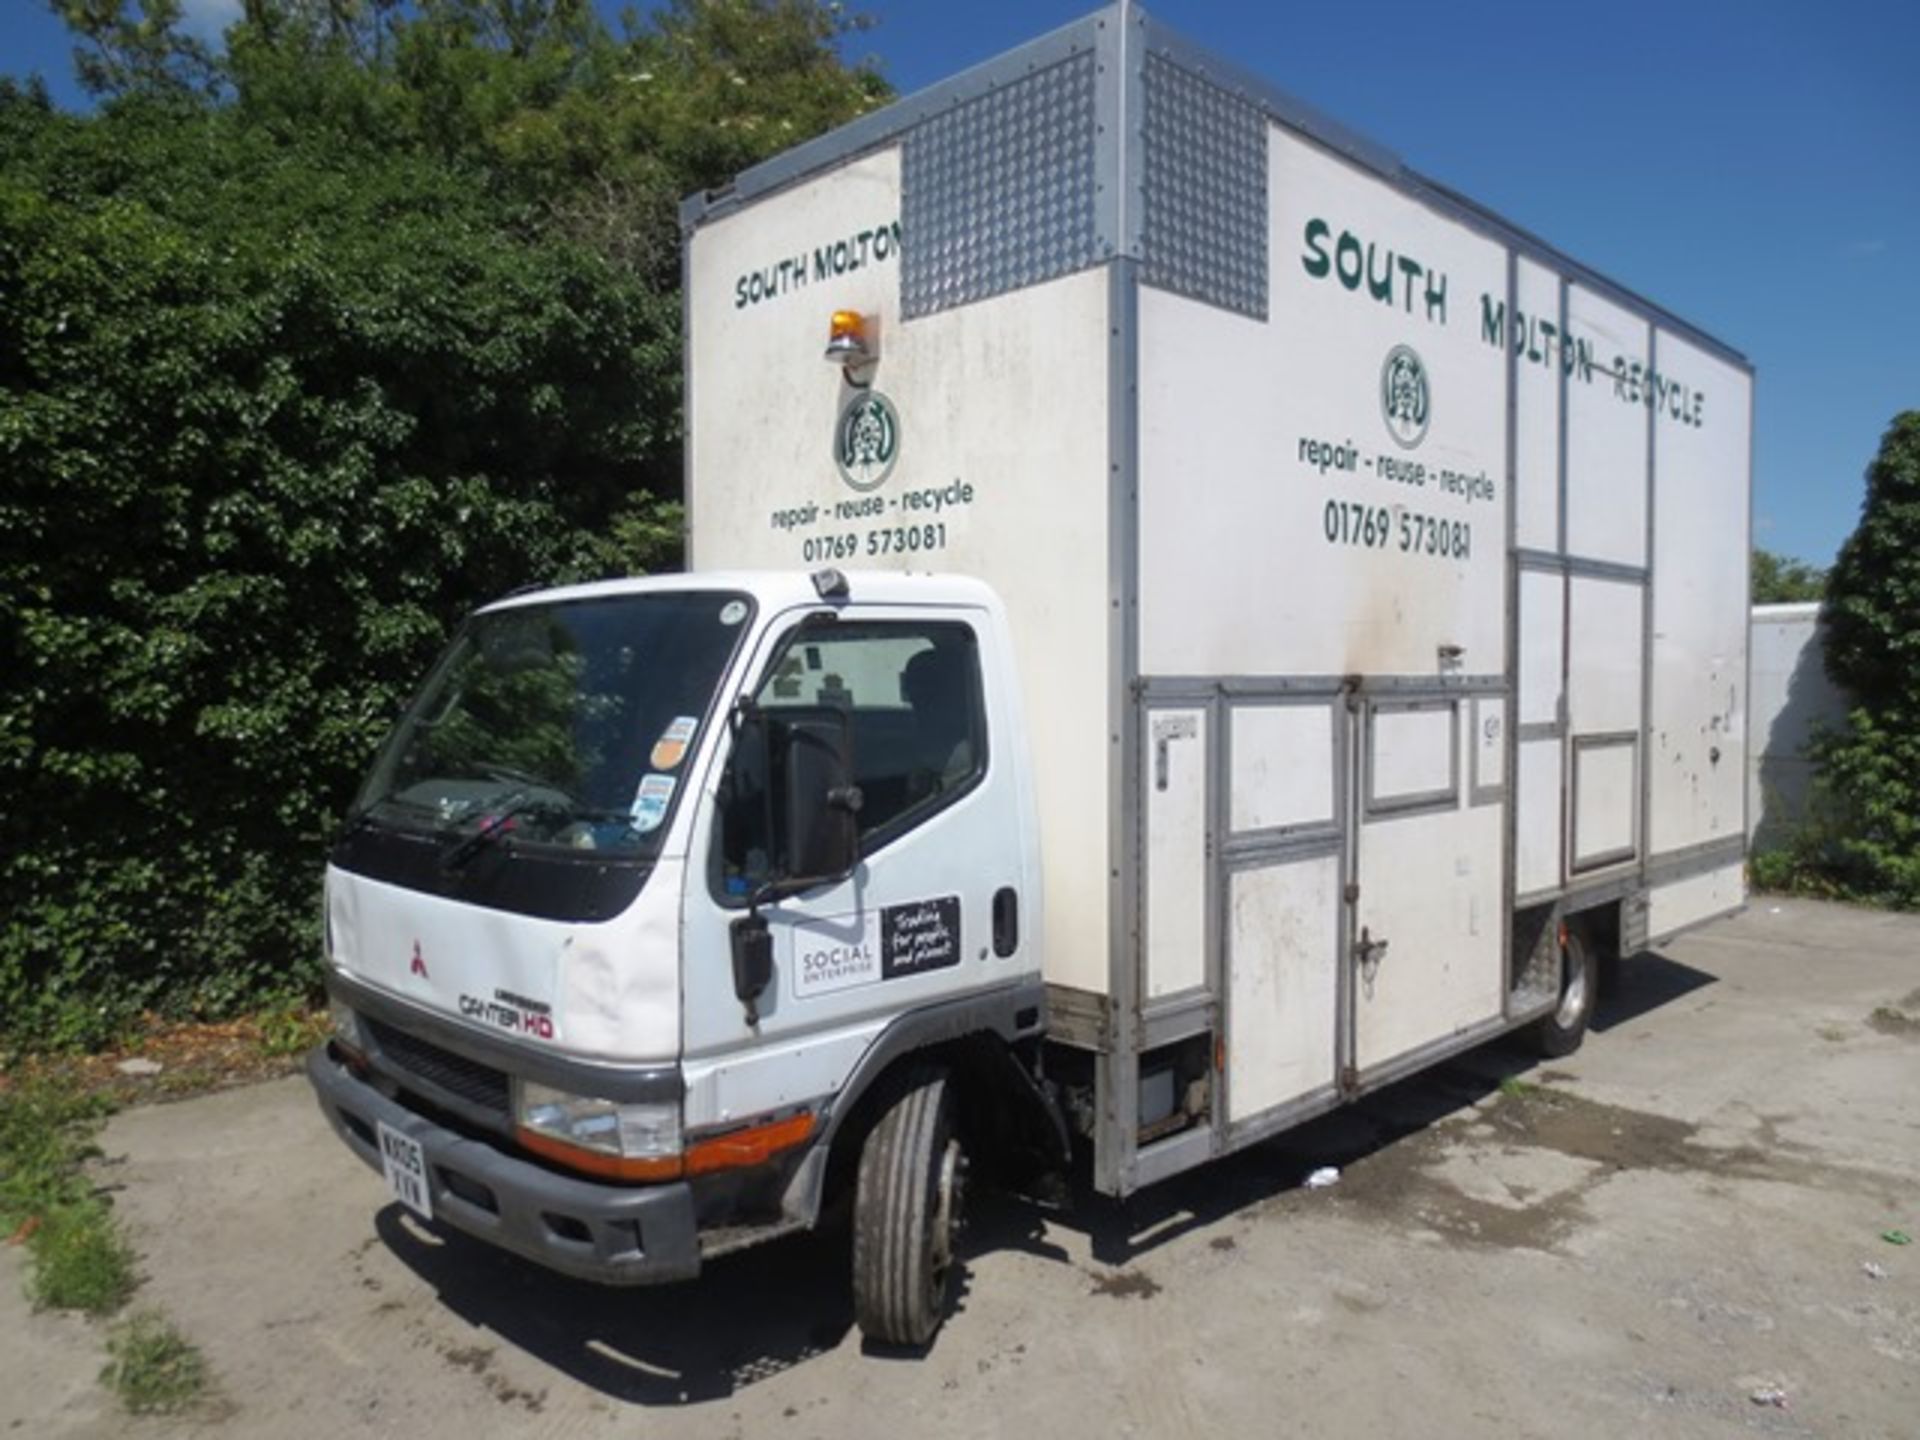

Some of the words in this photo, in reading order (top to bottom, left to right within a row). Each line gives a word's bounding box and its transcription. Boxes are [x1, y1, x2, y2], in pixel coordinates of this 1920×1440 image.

[735, 252, 808, 309] SOUTH
[1301, 217, 1447, 325] SOUTH
[1481, 292, 1593, 384] MOLTON
[1613, 355, 1704, 428] RECYCLE
[1298, 437, 1359, 475] repair
[1376, 455, 1425, 487] reuse
[1440, 471, 1494, 504] recycle
[770, 502, 819, 532] repair
[835, 496, 884, 520] reuse
[902, 478, 974, 512] recycle
[1324, 499, 1390, 549] 01769
[1399, 512, 1470, 559] 573081
[803, 537, 858, 562] 01769
[866, 523, 946, 556] 573081
[804, 944, 873, 970] SOCIAL
[804, 962, 872, 984] ENTERPRISE
[459, 994, 519, 1031] CANTER
[524, 1012, 553, 1039] HD
